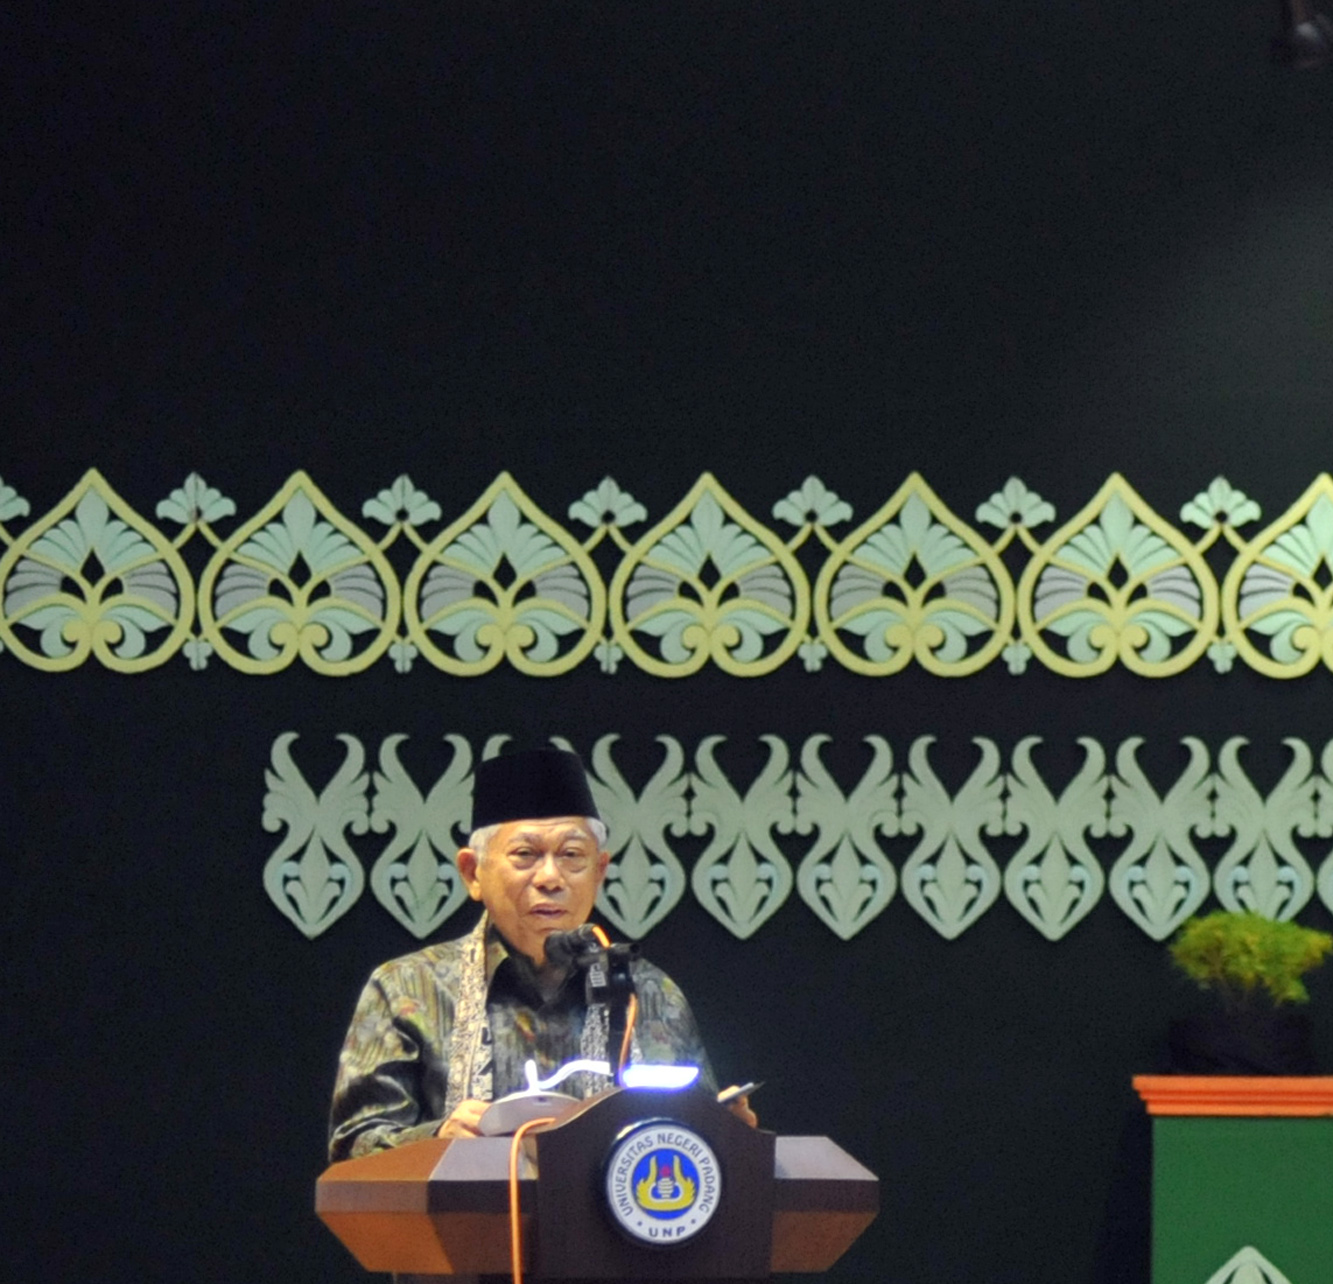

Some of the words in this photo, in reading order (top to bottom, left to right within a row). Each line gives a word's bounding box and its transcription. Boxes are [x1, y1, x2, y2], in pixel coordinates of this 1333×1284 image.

[615, 1135, 654, 1217] UNIVERSITAS
[657, 1132, 701, 1158] NEGERI
[698, 1156, 716, 1214] PADANG
[648, 1225, 687, 1238] UNP
